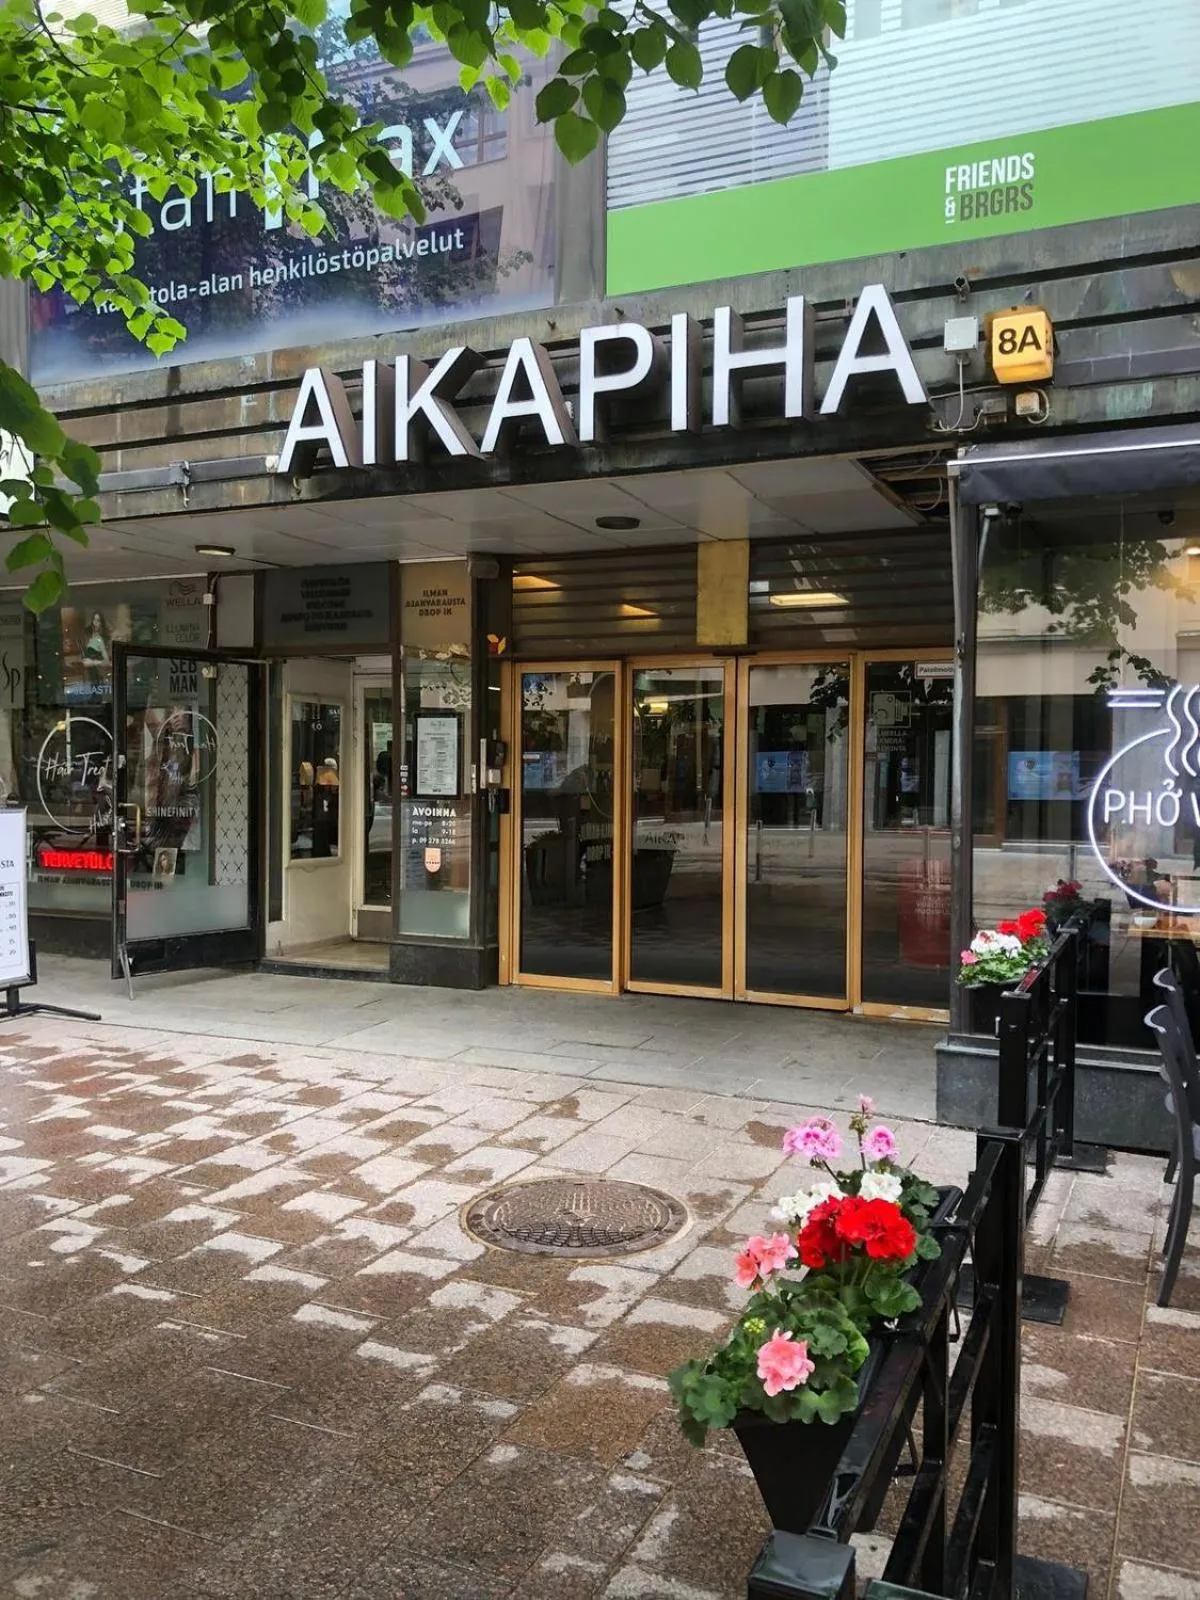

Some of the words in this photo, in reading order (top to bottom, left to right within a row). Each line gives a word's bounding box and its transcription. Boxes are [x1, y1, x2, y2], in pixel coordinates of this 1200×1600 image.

[945, 152, 1035, 193] FRIENDS
[945, 196, 956, 224] &
[960, 183, 1034, 221] BRGRS
[250, 228, 465, 288] henkilöstöpalvelut
[998, 325, 1042, 355] 8A
[277, 283, 928, 474] AIKAPIHA
[169, 675, 198, 693] MAN
[411, 806, 457, 817] AVOINNA
